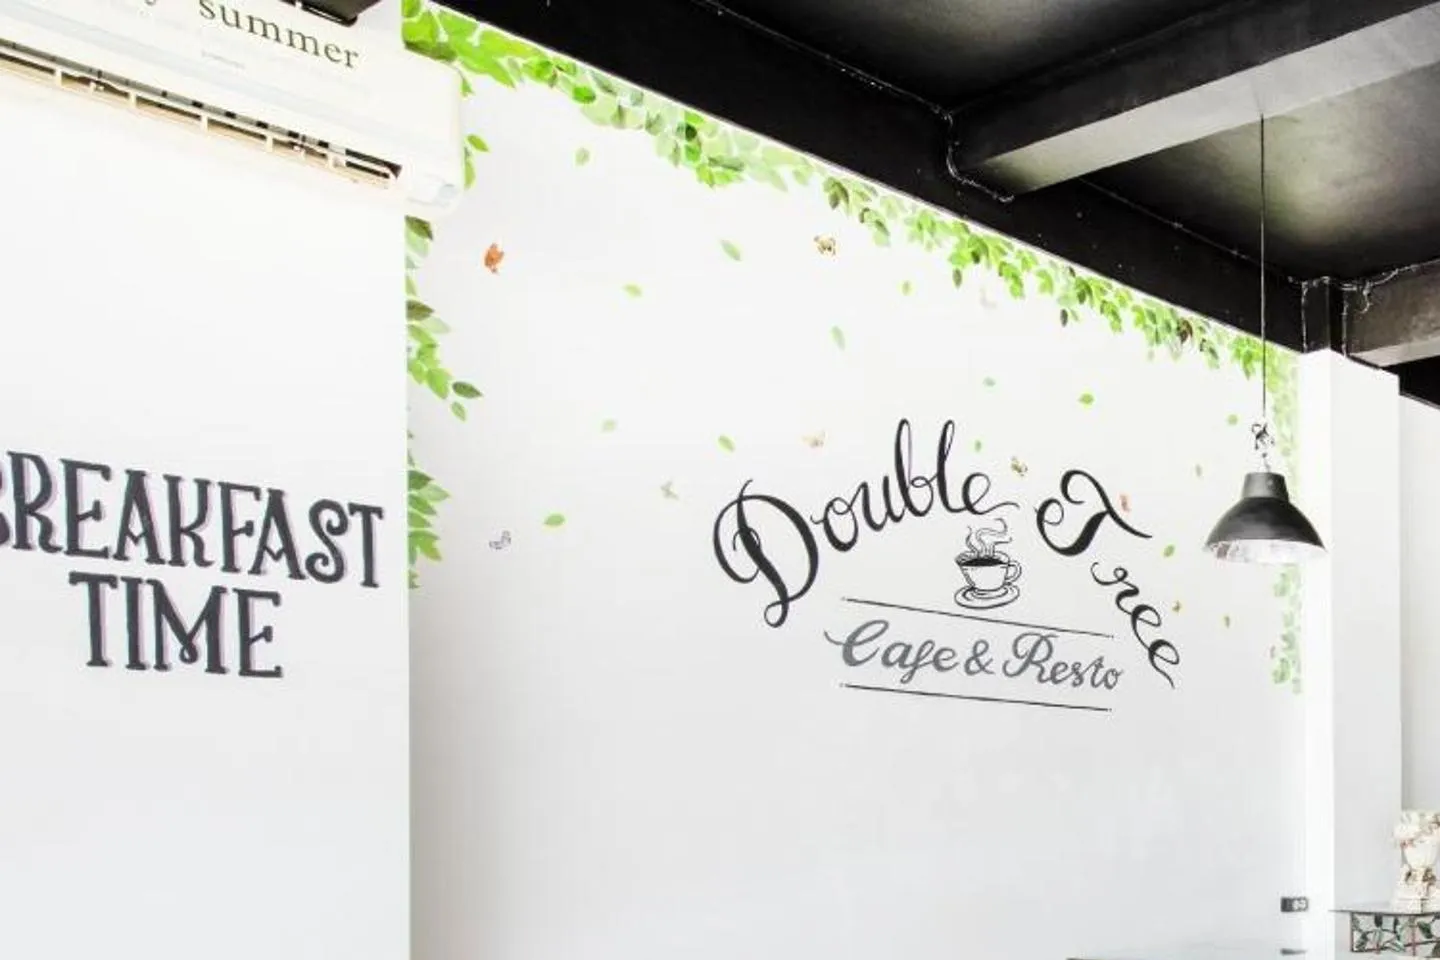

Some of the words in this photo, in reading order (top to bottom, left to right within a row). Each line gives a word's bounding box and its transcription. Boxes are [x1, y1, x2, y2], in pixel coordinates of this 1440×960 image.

[198, 0, 359, 69] summer
[0, 450, 384, 588] REAKFAST
[712, 418, 1021, 628] Double
[1034, 468, 1181, 689] Tree
[68, 570, 284, 679] TIME
[824, 618, 959, 684] Cafe
[964, 638, 994, 676] &
[1002, 630, 1124, 691] Resto
